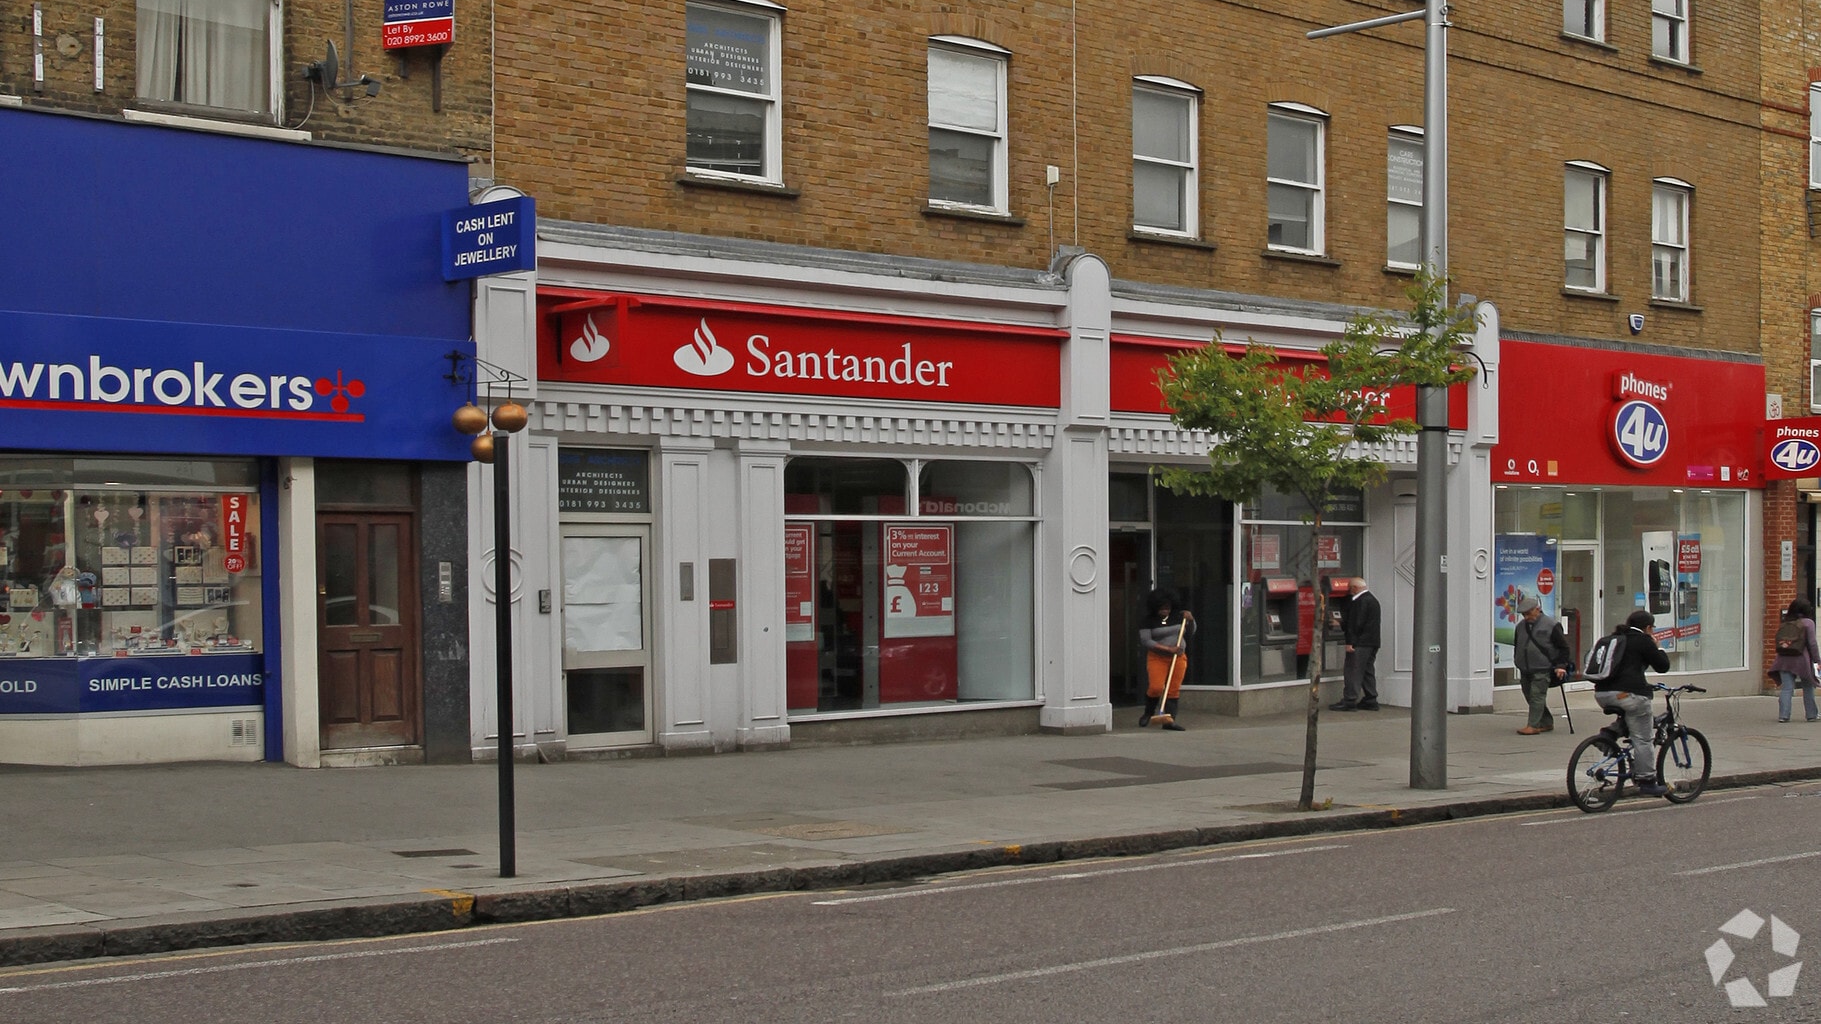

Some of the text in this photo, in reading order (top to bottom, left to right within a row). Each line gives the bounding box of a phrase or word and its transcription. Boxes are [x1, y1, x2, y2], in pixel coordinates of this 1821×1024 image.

[388, 0, 450, 12] ASTON ROWE
[387, 24, 414, 35] Let By
[386, 32, 448, 46] 020 8992 3600
[691, 48, 759, 64] URBAN DESIGNERS
[704, 42, 748, 55] ARCHITECTS
[686, 54, 764, 72] INTERIOR DESIGNERS
[688, 67, 765, 86] 0181 993 3435
[456, 211, 516, 234] CASH LENT
[477, 232, 494, 246] ON
[454, 244, 518, 267] JEWELLERY
[746, 334, 953, 387] Santander
[1620, 373, 1668, 401] phones
[1621, 406, 1664, 457] 4u
[1776, 425, 1820, 438] phones
[1775, 442, 1816, 468] 4u
[559, 500, 641, 509] 0181 993 3435
[228, 496, 241, 551] SALE
[891, 530, 907, 540] 3%
[914, 532, 940, 540] interest
[891, 549, 918, 557] Current
[902, 542, 919, 550] your
[0, 680, 37, 693] OLD
[89, 674, 263, 691] SIMPLE CASH LOANS
